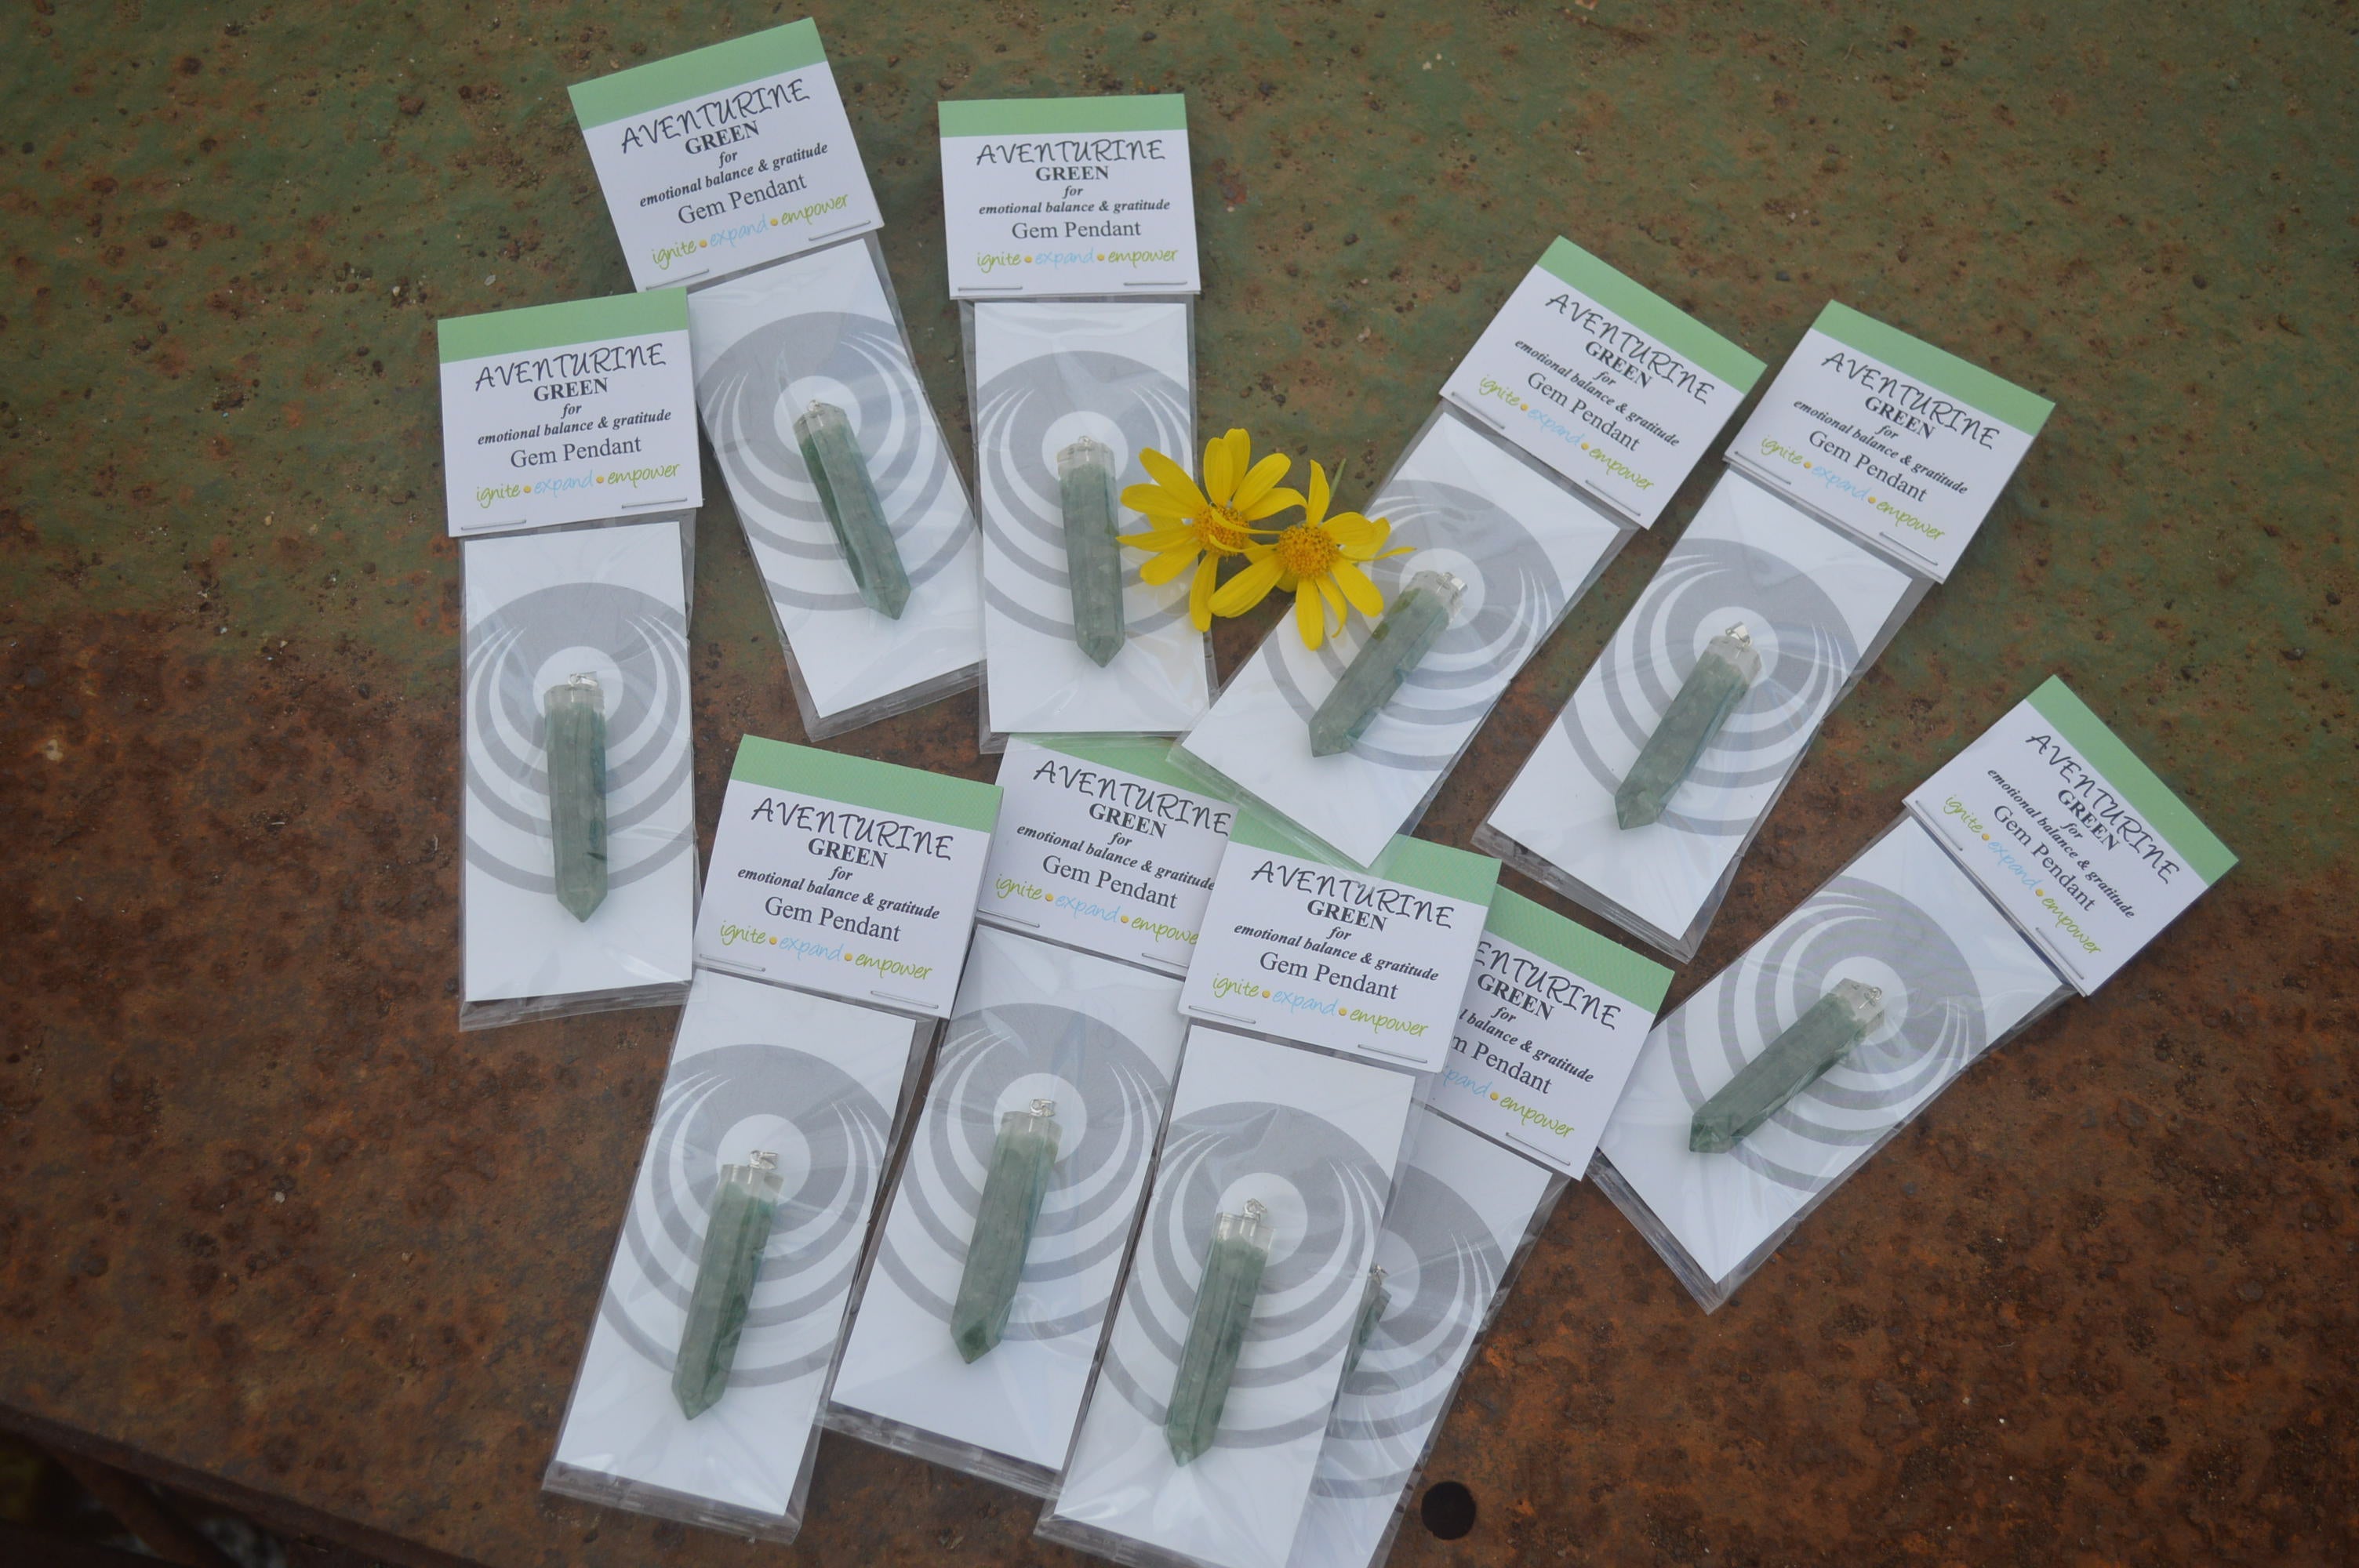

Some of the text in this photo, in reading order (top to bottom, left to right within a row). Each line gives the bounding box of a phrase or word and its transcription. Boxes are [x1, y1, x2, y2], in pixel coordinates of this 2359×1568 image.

[620, 77, 811, 154] AVENTURINE
[685, 120, 759, 154] GREEN
[639, 142, 828, 207] emotional balance & gratitude
[718, 151, 738, 169] for
[976, 140, 1165, 165] AVENTURINE
[1036, 166, 1108, 181] GREEN
[678, 173, 808, 224] Gem Pendant
[979, 199, 1170, 214] emotional balance & gratitude
[1062, 185, 1083, 199] for
[651, 194, 849, 271] ignite expand empower
[1012, 220, 1141, 238] Gem Pendant
[977, 248, 1178, 274] ignite expand empower
[474, 342, 667, 391] AVENTURINE
[1544, 294, 1715, 405] AVENTURINE
[1584, 341, 1652, 389] GREEN
[534, 378, 608, 402] GREEN
[1514, 340, 1679, 447] emotional balance & gratitude
[1591, 371, 1616, 386] for
[1820, 352, 2001, 451] AVENTURINE
[478, 408, 671, 445] emotional balance & gratitude
[560, 402, 582, 419] for
[1478, 374, 1655, 492] ignite expand empower
[1527, 372, 1640, 452] Gem Pendant
[1864, 396, 1935, 439] GREEN
[1874, 425, 1899, 439] for
[510, 437, 642, 468] Gem Pendant
[1793, 401, 1968, 495] emotional balance & gratitude
[1808, 430, 1928, 503] Gem Pendant
[476, 463, 680, 510] ignite expand empower
[1760, 434, 1946, 541] ignite expand empower
[1032, 760, 1232, 837] AVENTURINE
[1089, 803, 1166, 839] GREEN
[2025, 735, 2180, 884] AVENTURINE
[2057, 789, 2119, 851] GREEN
[751, 797, 954, 861] AVENTURINE
[808, 838, 887, 869] GREEN
[1107, 832, 1132, 847] for
[1987, 769, 2135, 918] emotional balance & gratitude
[2059, 822, 2083, 838] for
[827, 866, 853, 881] for
[1016, 826, 1215, 891] emotional balance & gratitude
[1042, 855, 1177, 909] Gem Pendant
[1942, 793, 2102, 955] ignite expand empower
[1994, 805, 2095, 912] Gem Pendant
[737, 869, 940, 920] emotional balance & gratitude
[764, 895, 901, 942] Gem Pendant
[994, 873, 1198, 945] ignite expand empowe
[1249, 861, 1454, 928] AVENTURINE
[1307, 899, 1387, 931] GREEN
[719, 920, 932, 981] ignite expand empower
[1232, 924, 1439, 982] emotional balance & gratitude
[1325, 926, 1352, 940] for
[1259, 951, 1398, 1000] Gem Pendant
[1475, 940, 1622, 1031] ENTURINE
[1477, 974, 1554, 1021] GREEN
[1211, 972, 1262, 999] ignite
[1270, 990, 1339, 1015] expand
[1349, 1008, 1429, 1038] empower
[1489, 1007, 1517, 1022] for
[1466, 1012, 1518, 1046] balance
[1519, 1040, 1532, 1054] &
[1532, 1049, 1594, 1083] gratitude
[1471, 1041, 1552, 1095] Pendant
[1499, 1095, 1575, 1138] empower
